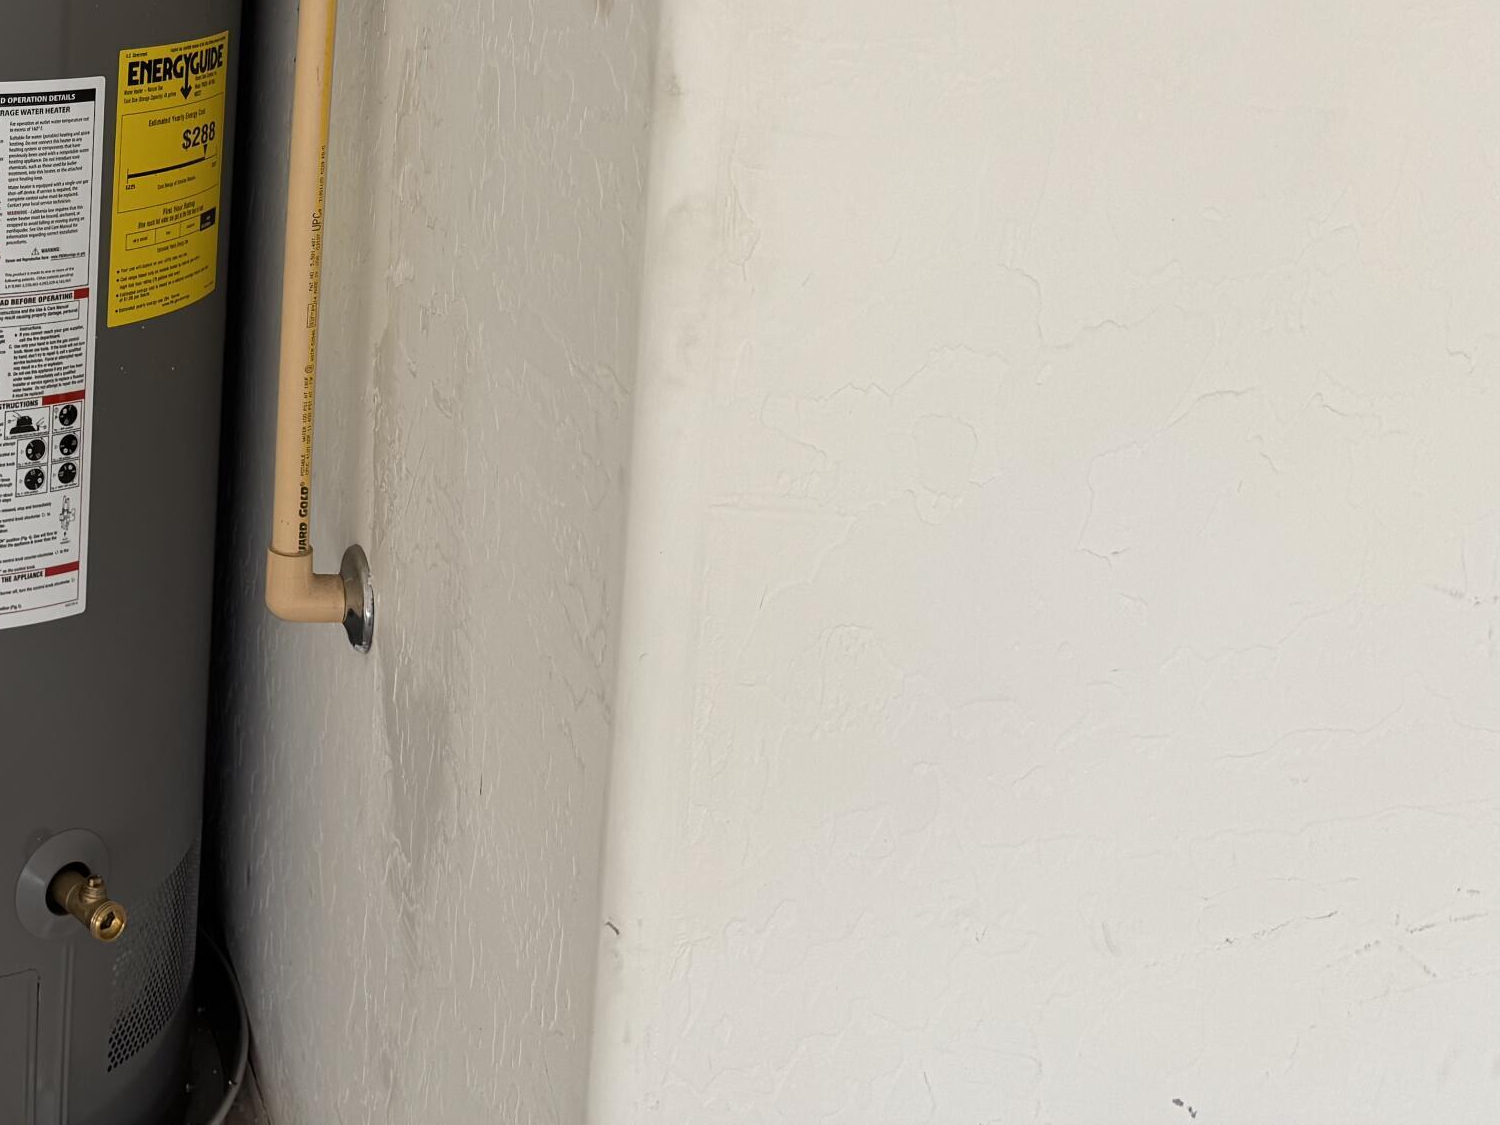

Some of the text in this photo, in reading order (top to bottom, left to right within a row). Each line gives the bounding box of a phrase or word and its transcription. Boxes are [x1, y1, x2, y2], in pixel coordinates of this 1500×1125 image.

[127, 43, 224, 87] ENERGYGUIDE
[7, 94, 47, 103] OPERATION
[48, 93, 76, 102] DETAILS
[20, 107, 43, 115] WATER
[44, 106, 70, 114] HEATER
[182, 121, 216, 151] $288
[10, 295, 36, 305] BEFORE
[38, 293, 72, 303] OPERATING
[1, 575, 11, 583] THE
[13, 570, 43, 581] APPLIANCE
